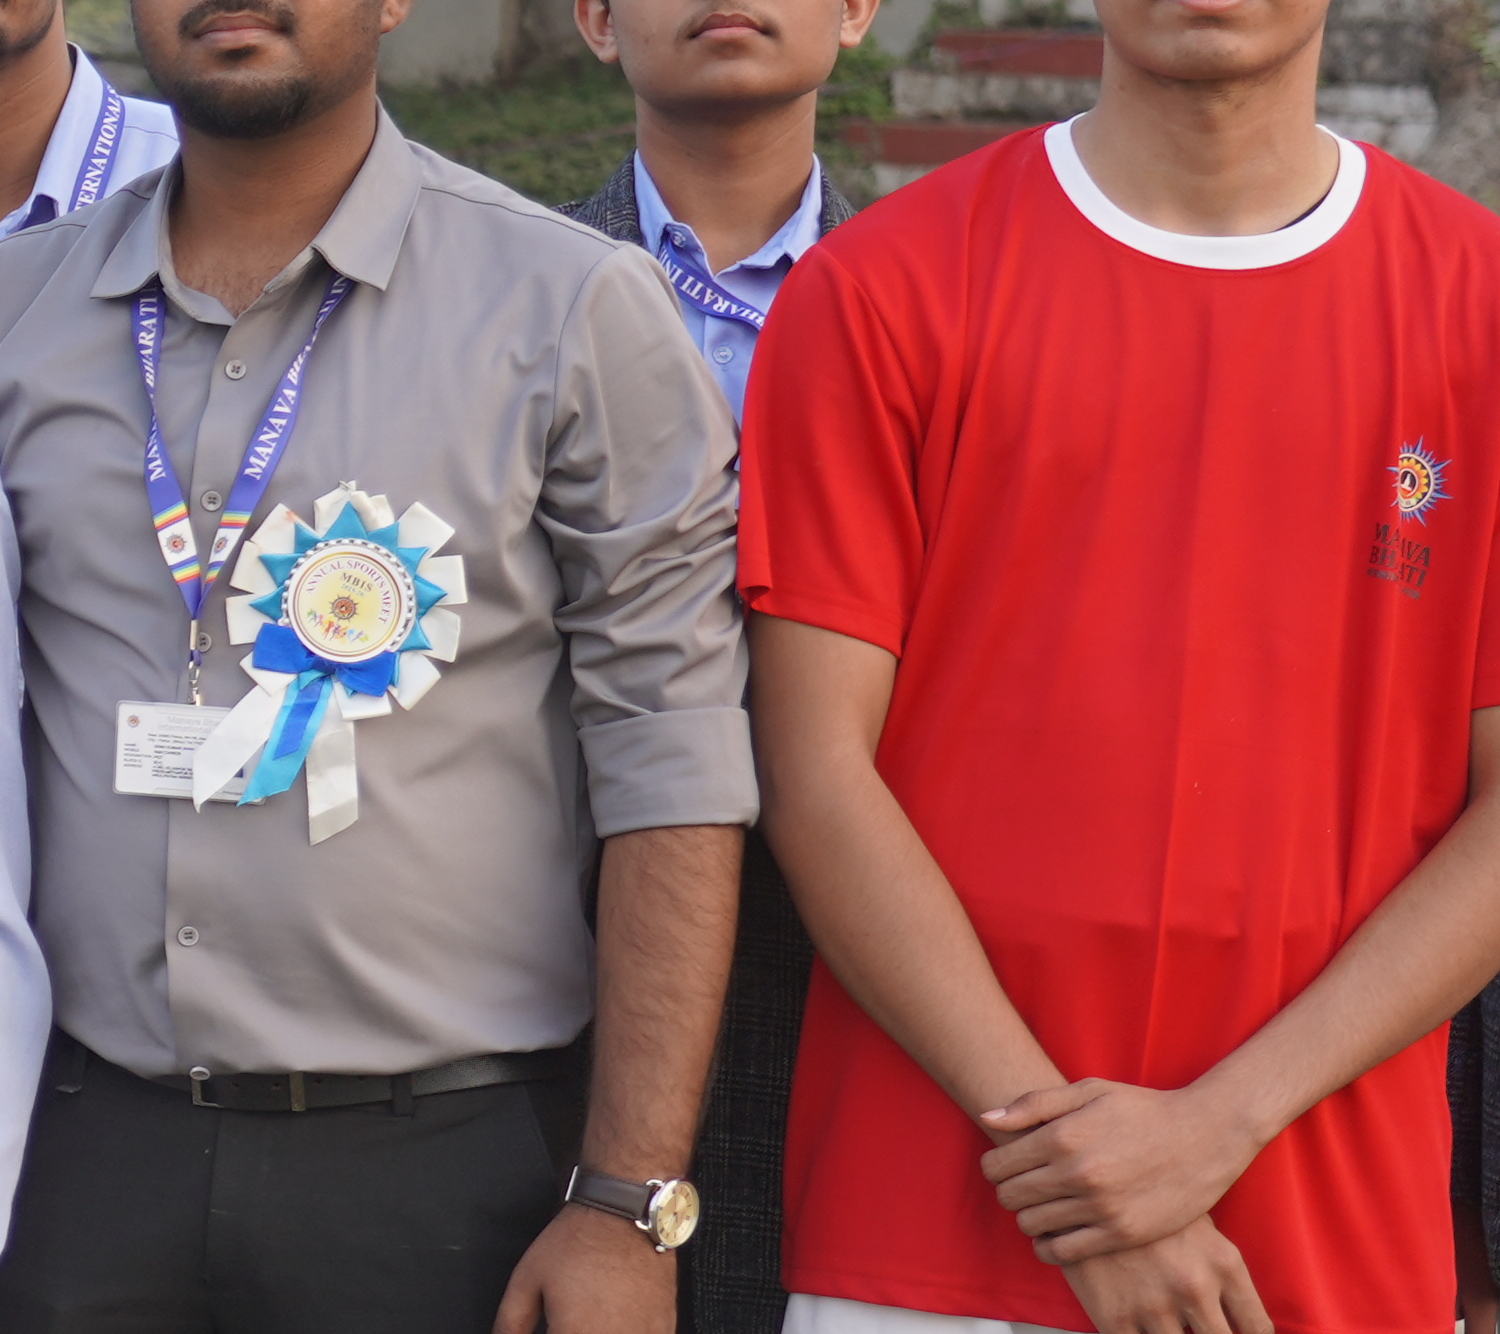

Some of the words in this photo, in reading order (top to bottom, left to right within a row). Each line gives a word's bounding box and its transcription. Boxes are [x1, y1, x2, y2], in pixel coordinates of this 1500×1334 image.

[138, 296, 158, 388] BHARATI
[243, 387, 297, 481] MANAVA
[305, 560, 345, 595] ANNUAL
[346, 559, 386, 589] SPORTS
[378, 589, 392, 624] MEET
[340, 572, 374, 593] MBIS
